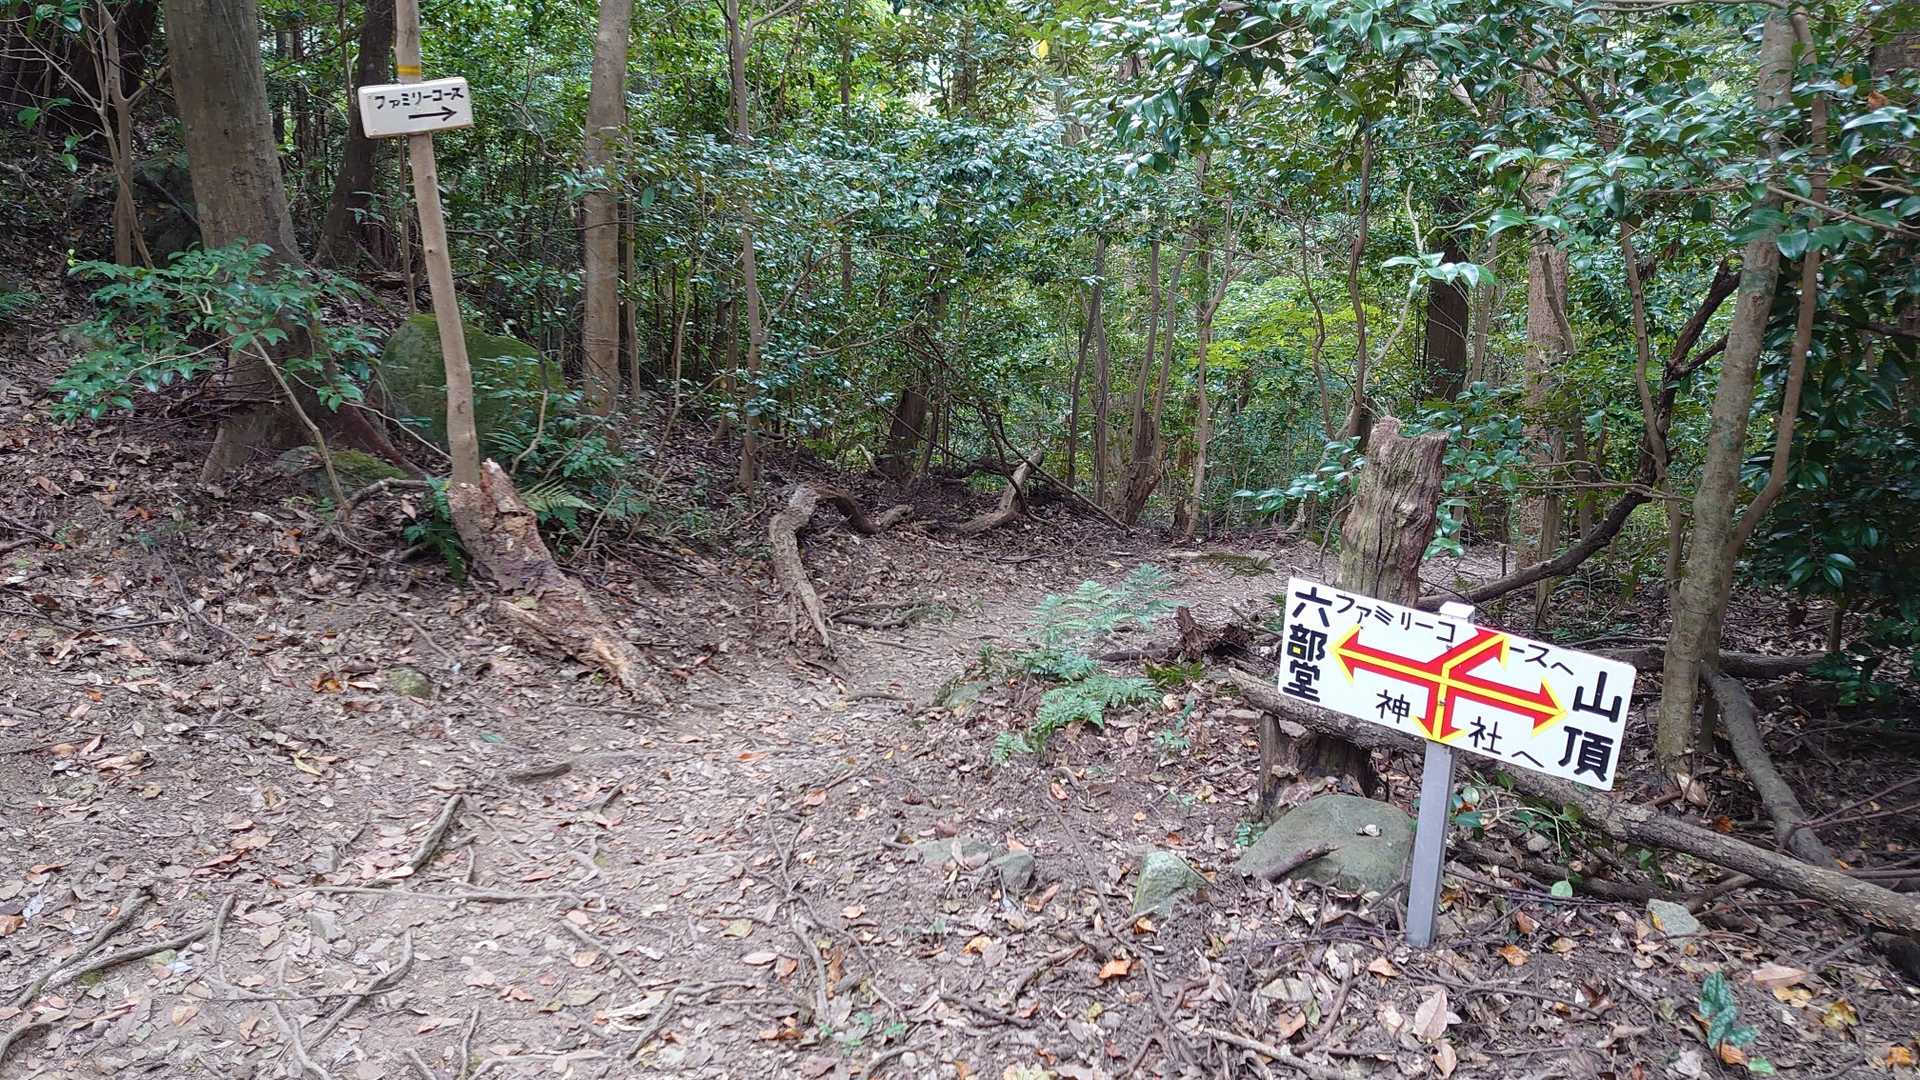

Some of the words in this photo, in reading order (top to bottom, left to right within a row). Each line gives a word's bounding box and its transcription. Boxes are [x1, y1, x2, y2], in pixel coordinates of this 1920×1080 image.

[374, 87, 464, 110] ファミリーコース
[1282, 586, 1333, 702] 六部堂
[1558, 670, 1623, 783] 山頂
